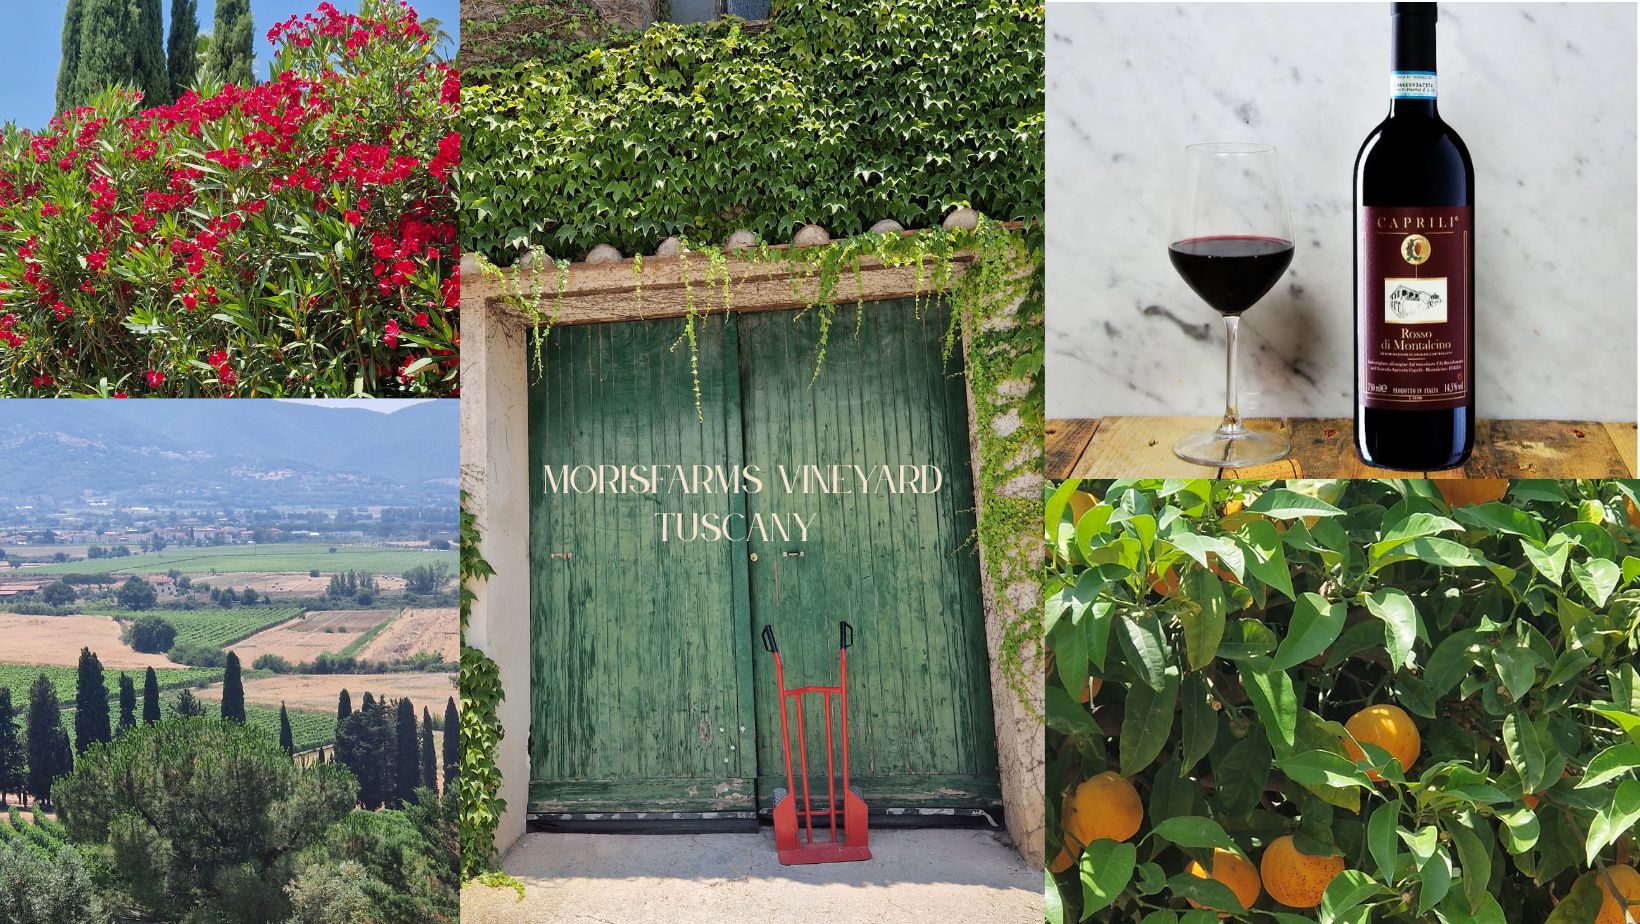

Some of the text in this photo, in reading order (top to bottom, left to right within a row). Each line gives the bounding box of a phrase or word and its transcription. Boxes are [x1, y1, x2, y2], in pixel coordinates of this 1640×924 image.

[1377, 216, 1454, 228] CAPRILI
[1401, 328, 1432, 339] Rosso
[1381, 339, 1451, 351] di Montalcino
